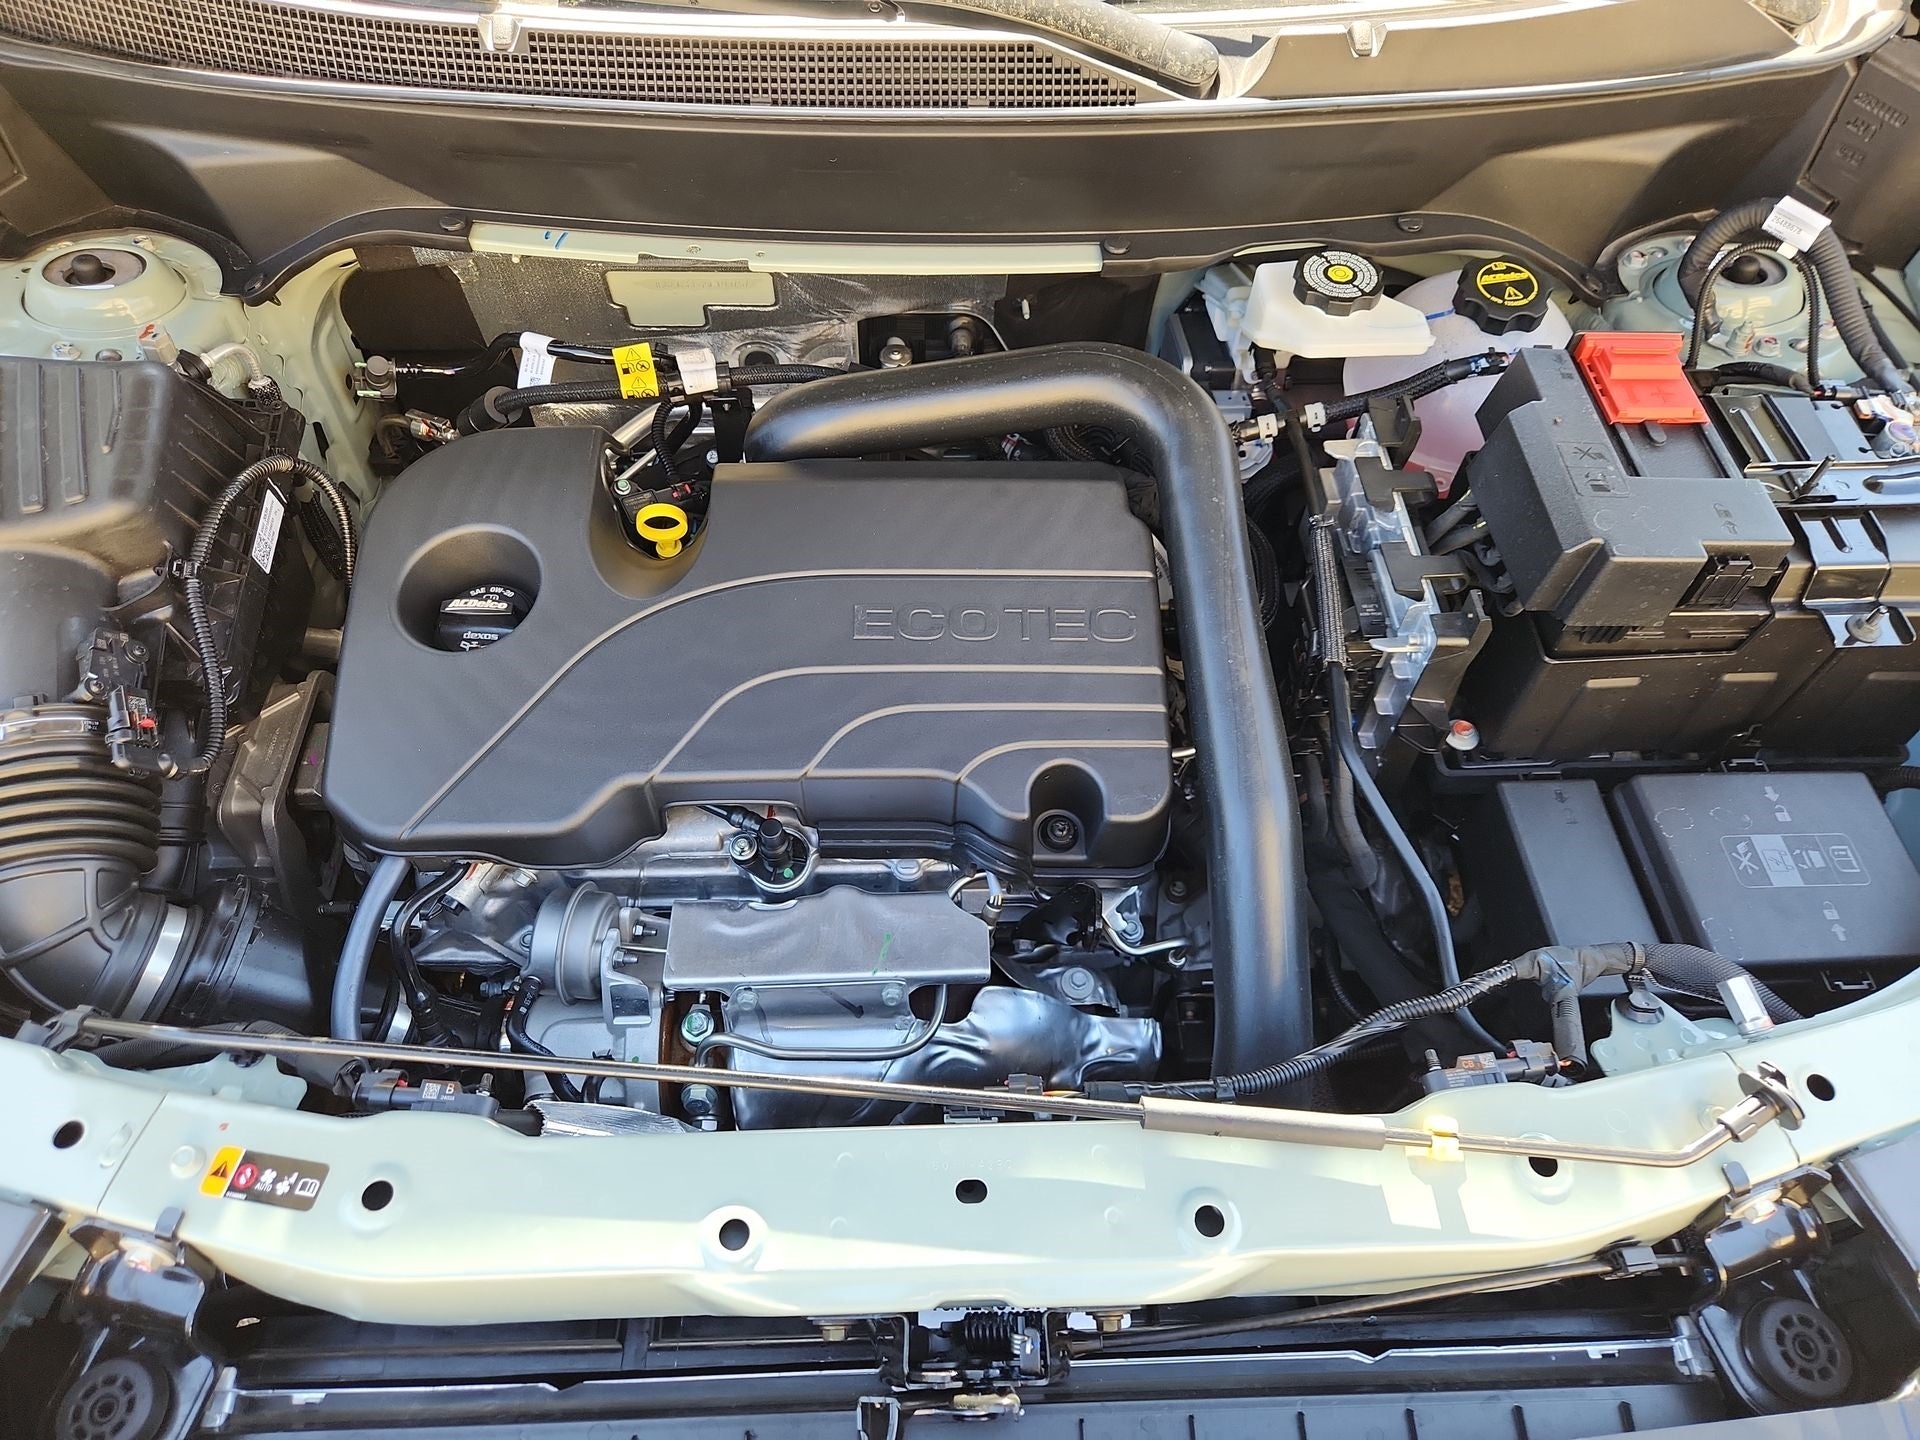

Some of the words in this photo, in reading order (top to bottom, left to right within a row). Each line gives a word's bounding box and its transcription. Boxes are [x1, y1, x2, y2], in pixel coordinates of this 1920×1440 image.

[469, 587, 486, 597] SAE
[489, 586, 515, 598] 0W-20
[447, 598, 508, 609] ACDelco
[852, 603, 1137, 642] ECOTEC
[463, 631, 498, 641] dexos
[445, 1083, 455, 1094] B
[254, 1183, 272, 1192] AUTO
